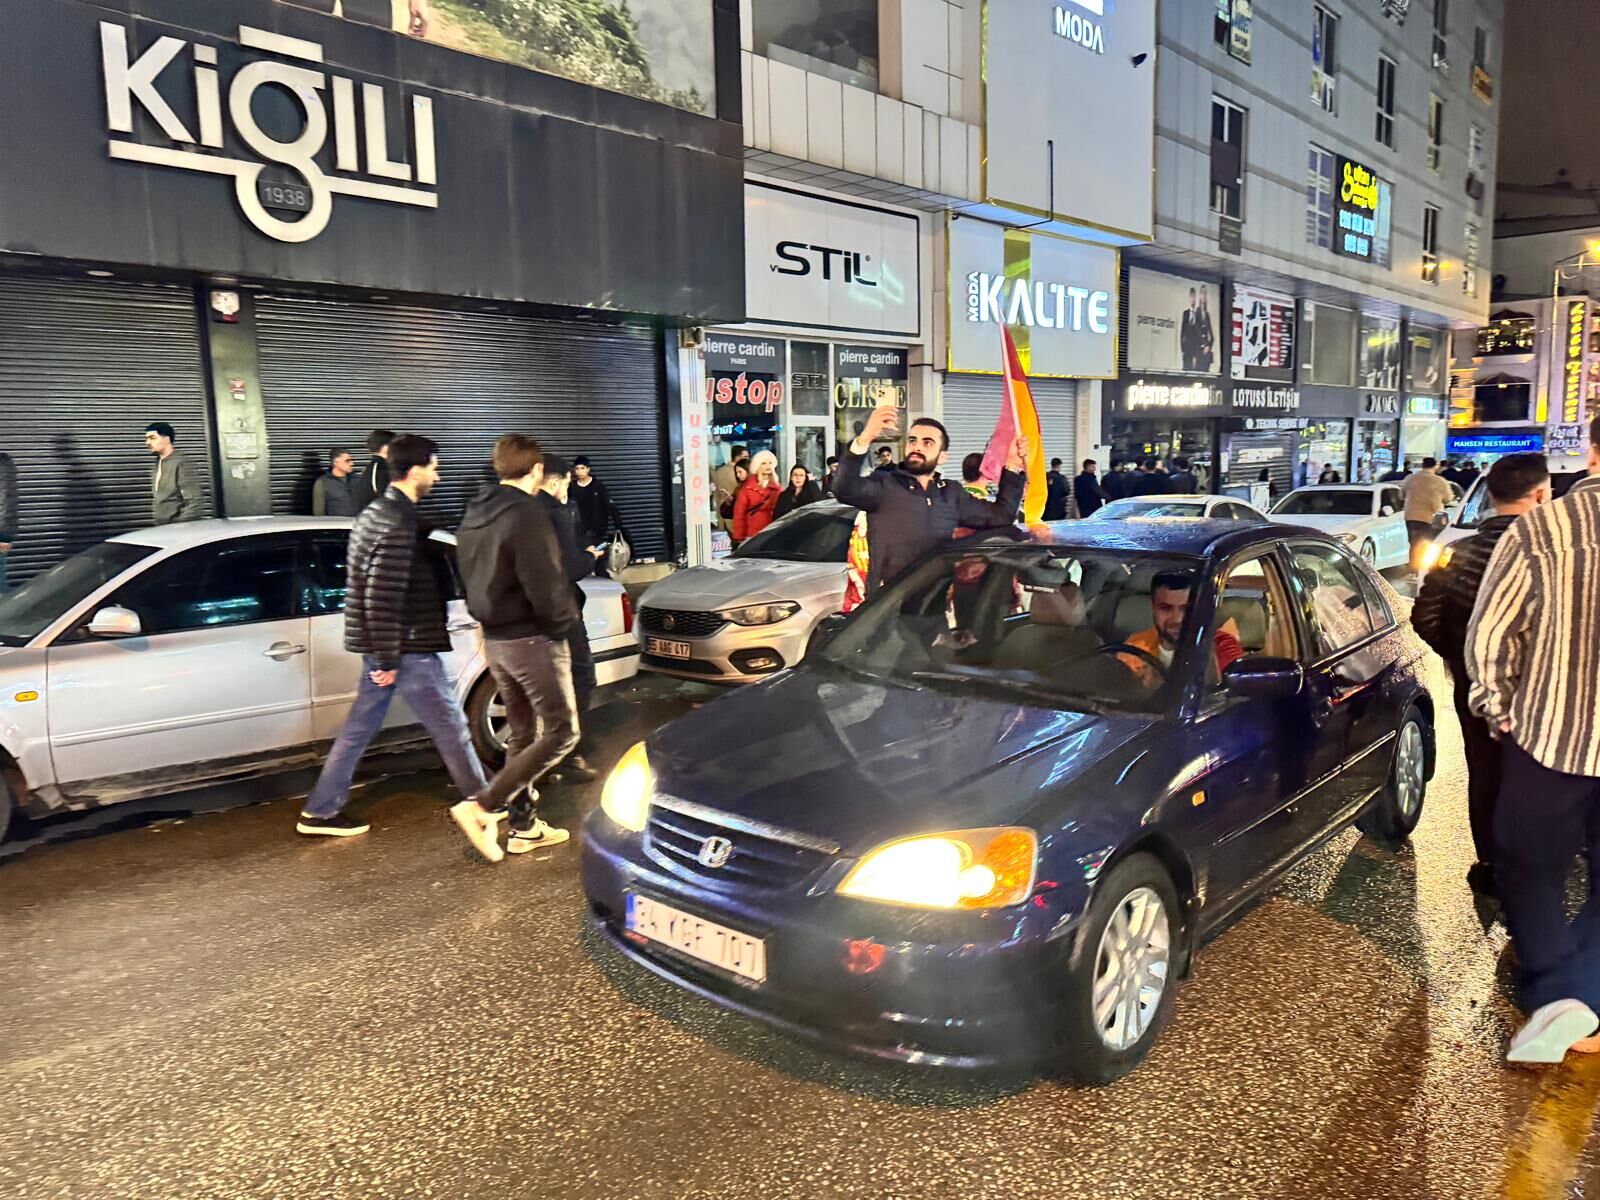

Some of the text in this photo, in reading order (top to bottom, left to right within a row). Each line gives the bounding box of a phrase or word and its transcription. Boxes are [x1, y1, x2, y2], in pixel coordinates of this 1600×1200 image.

[1056, 6, 1104, 54] MODA
[263, 185, 307, 207] 1938
[968, 271, 979, 322] MODA
[738, 342, 776, 357] cardin
[839, 349, 900, 365] pierre cardin
[834, 383, 906, 409] CLISE
[1127, 380, 1170, 411] pierre
[1233, 388, 1266, 408] LOTUSS
[716, 931, 757, 973] 707
